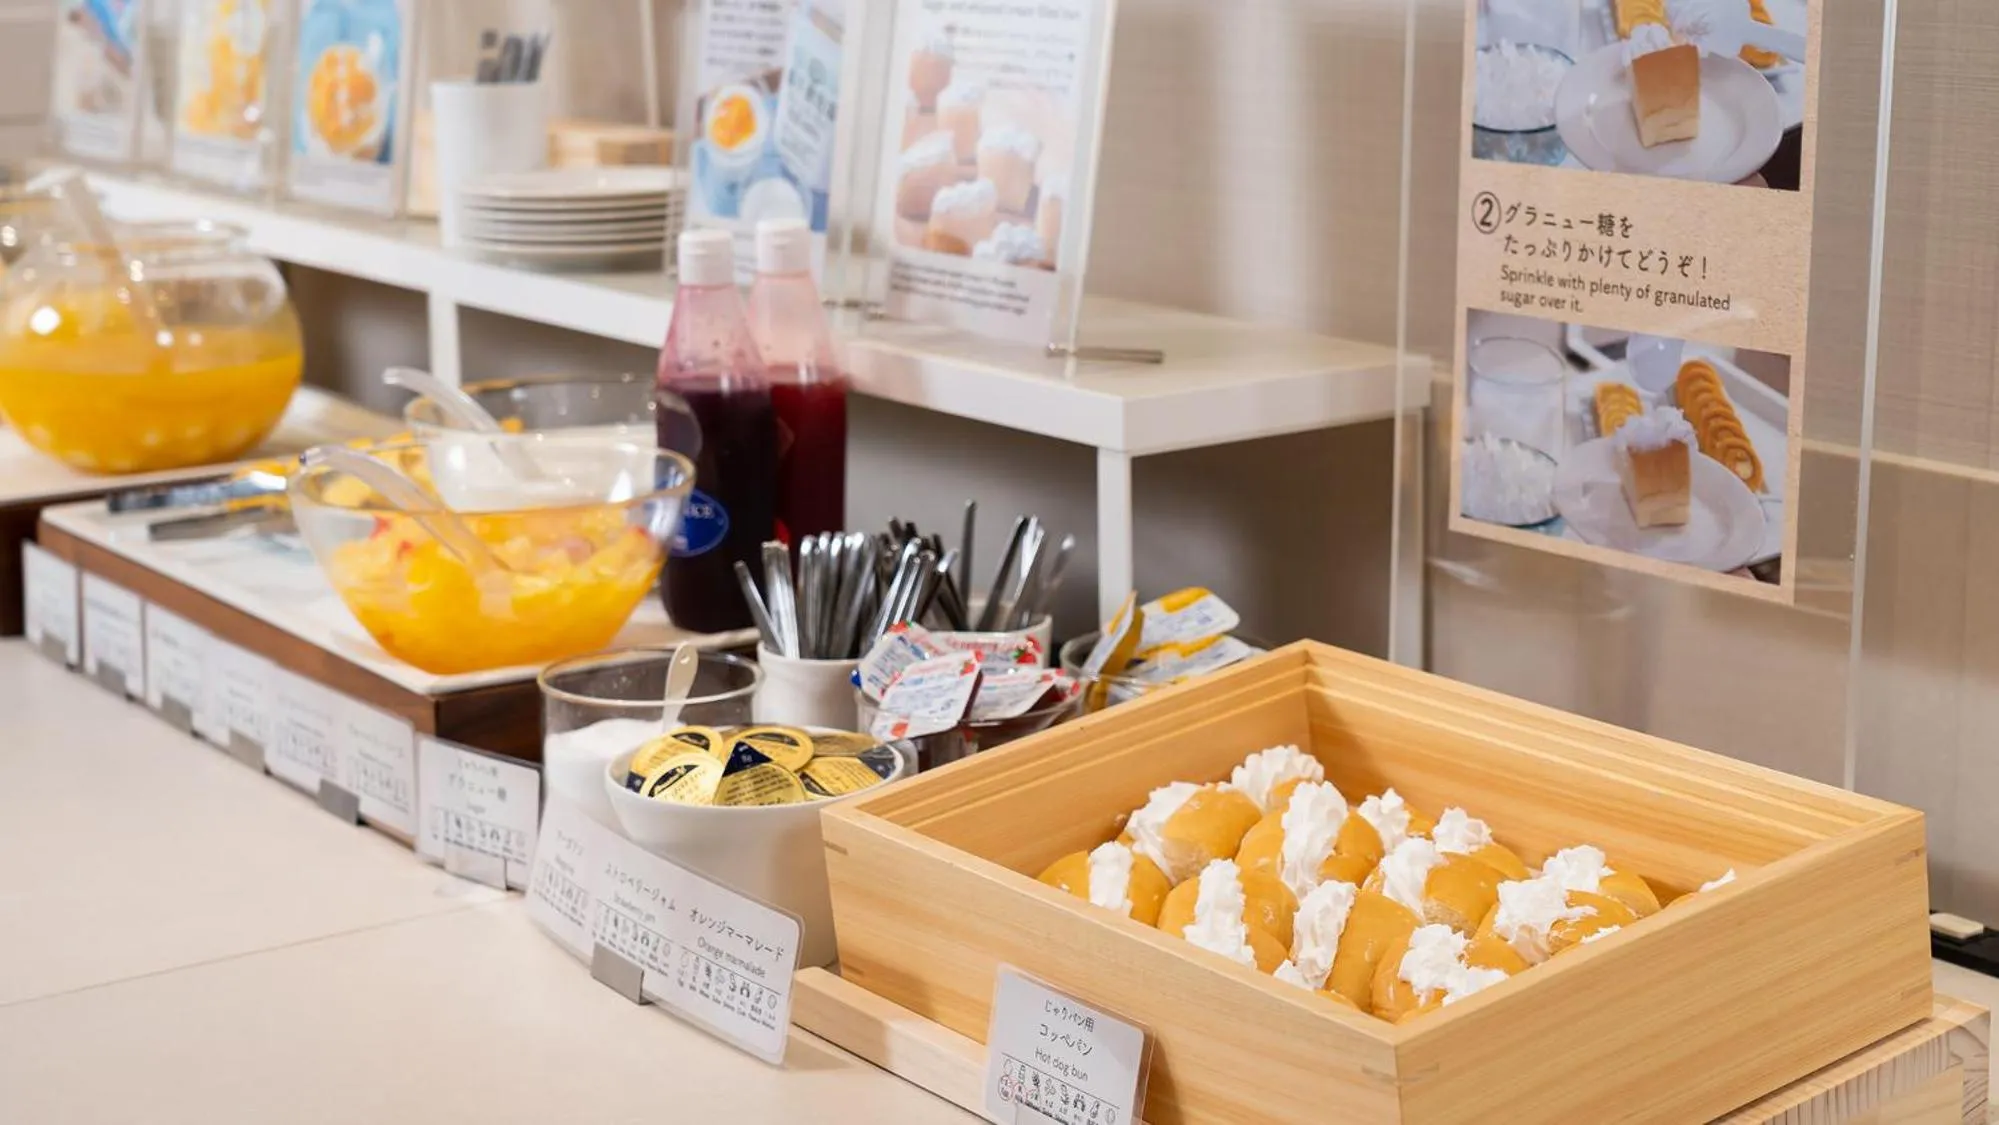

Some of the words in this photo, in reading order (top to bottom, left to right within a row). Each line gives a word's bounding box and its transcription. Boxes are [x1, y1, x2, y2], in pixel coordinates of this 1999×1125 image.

[1504, 202, 1634, 239] グラニュー糖を
[1500, 264, 1555, 289] Sprinkle
[1557, 274, 1586, 292] with
[1589, 277, 1632, 301] plenty
[1635, 284, 1652, 299] of
[1654, 289, 1731, 311] granulated
[1500, 290, 1535, 309] sugar
[1538, 294, 1567, 309] over
[1569, 297, 1584, 312] it.
[690, 907, 785, 961] オレンジマーマレード
[697, 935, 723, 960] Orange
[1039, 1023, 1094, 1056] コッペパン
[1035, 1047, 1051, 1064] Hot
[1052, 1056, 1070, 1077] dog
[1071, 1063, 1089, 1082] bun
